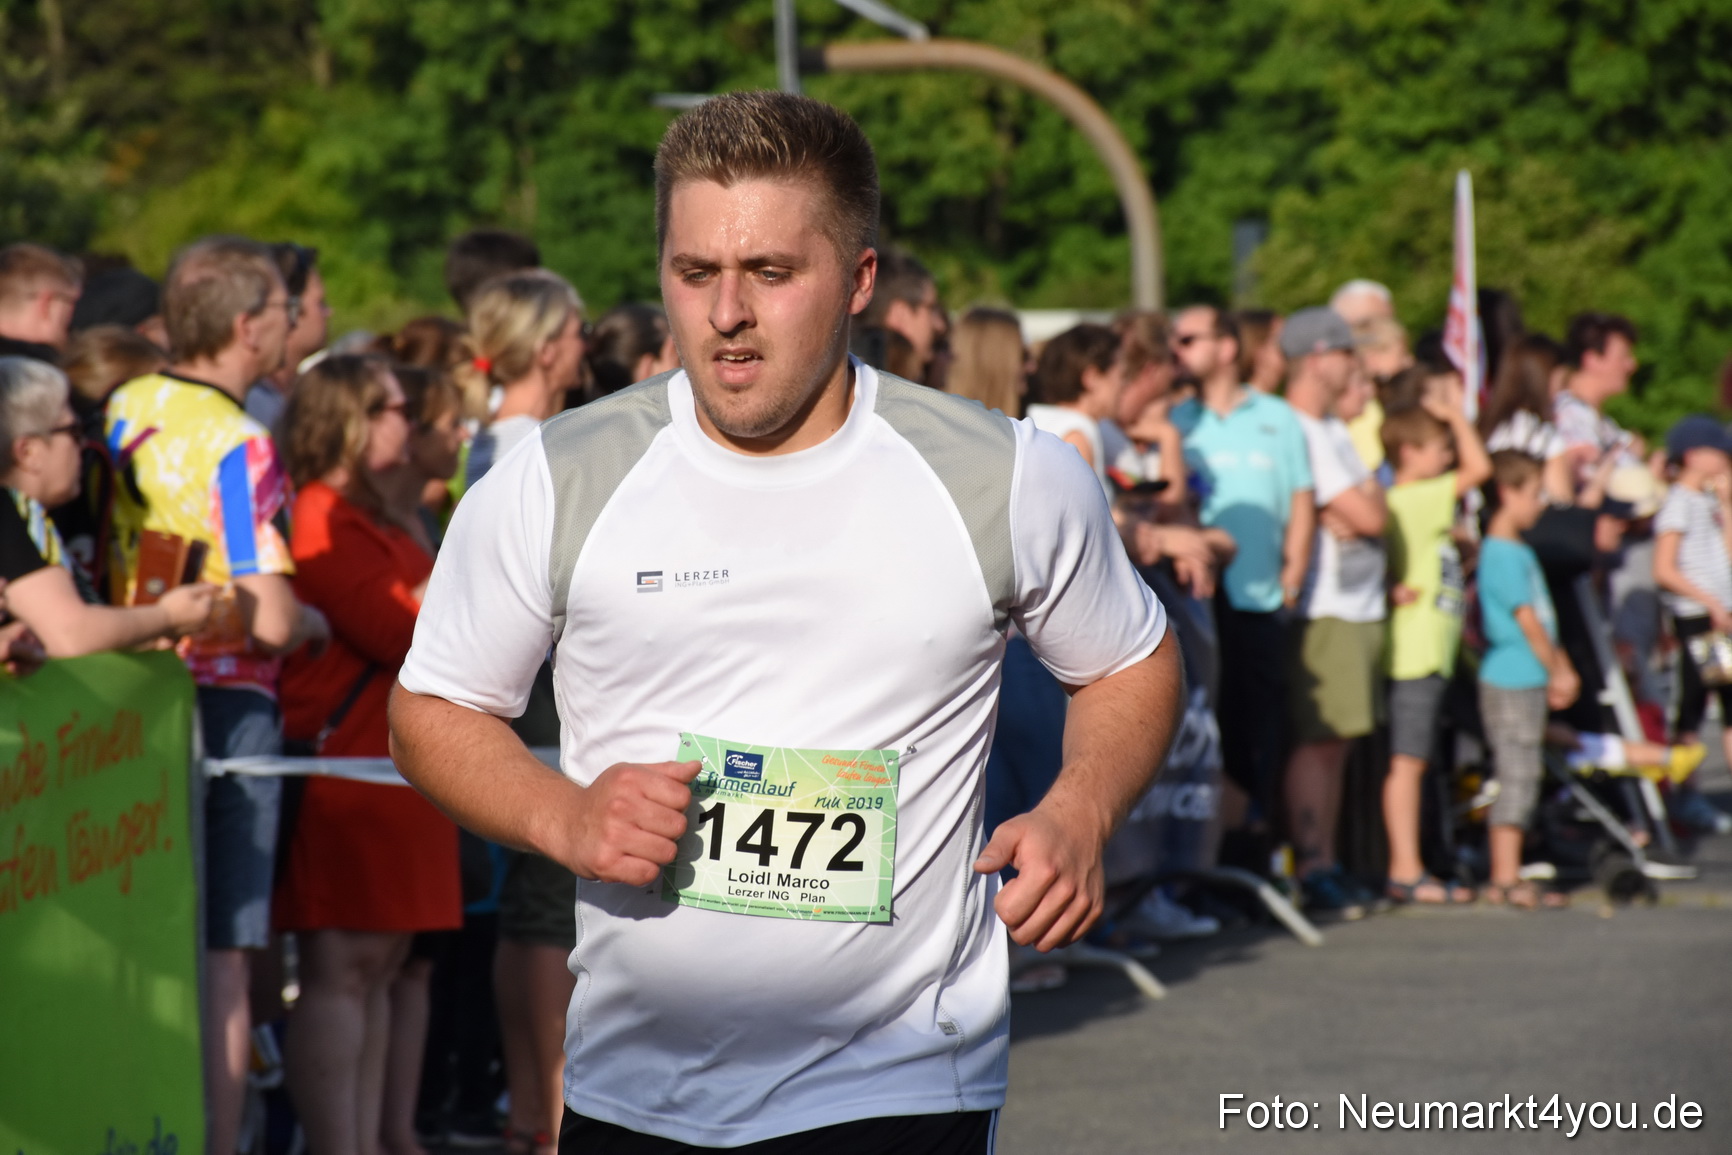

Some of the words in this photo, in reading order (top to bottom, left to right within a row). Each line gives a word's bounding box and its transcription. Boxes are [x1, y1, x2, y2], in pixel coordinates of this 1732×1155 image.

[675, 569, 729, 582] LERZER
[730, 756, 758, 768] Fischer
[706, 771, 797, 797] firmenlauf
[705, 788, 744, 798] neumarkt
[846, 796, 884, 810] 2019
[698, 802, 866, 872] 1472
[727, 867, 771, 886] Loidl
[776, 873, 830, 890] Marco
[727, 885, 765, 899] Lerzer
[767, 889, 790, 901] ING
[800, 892, 826, 904] Plan
